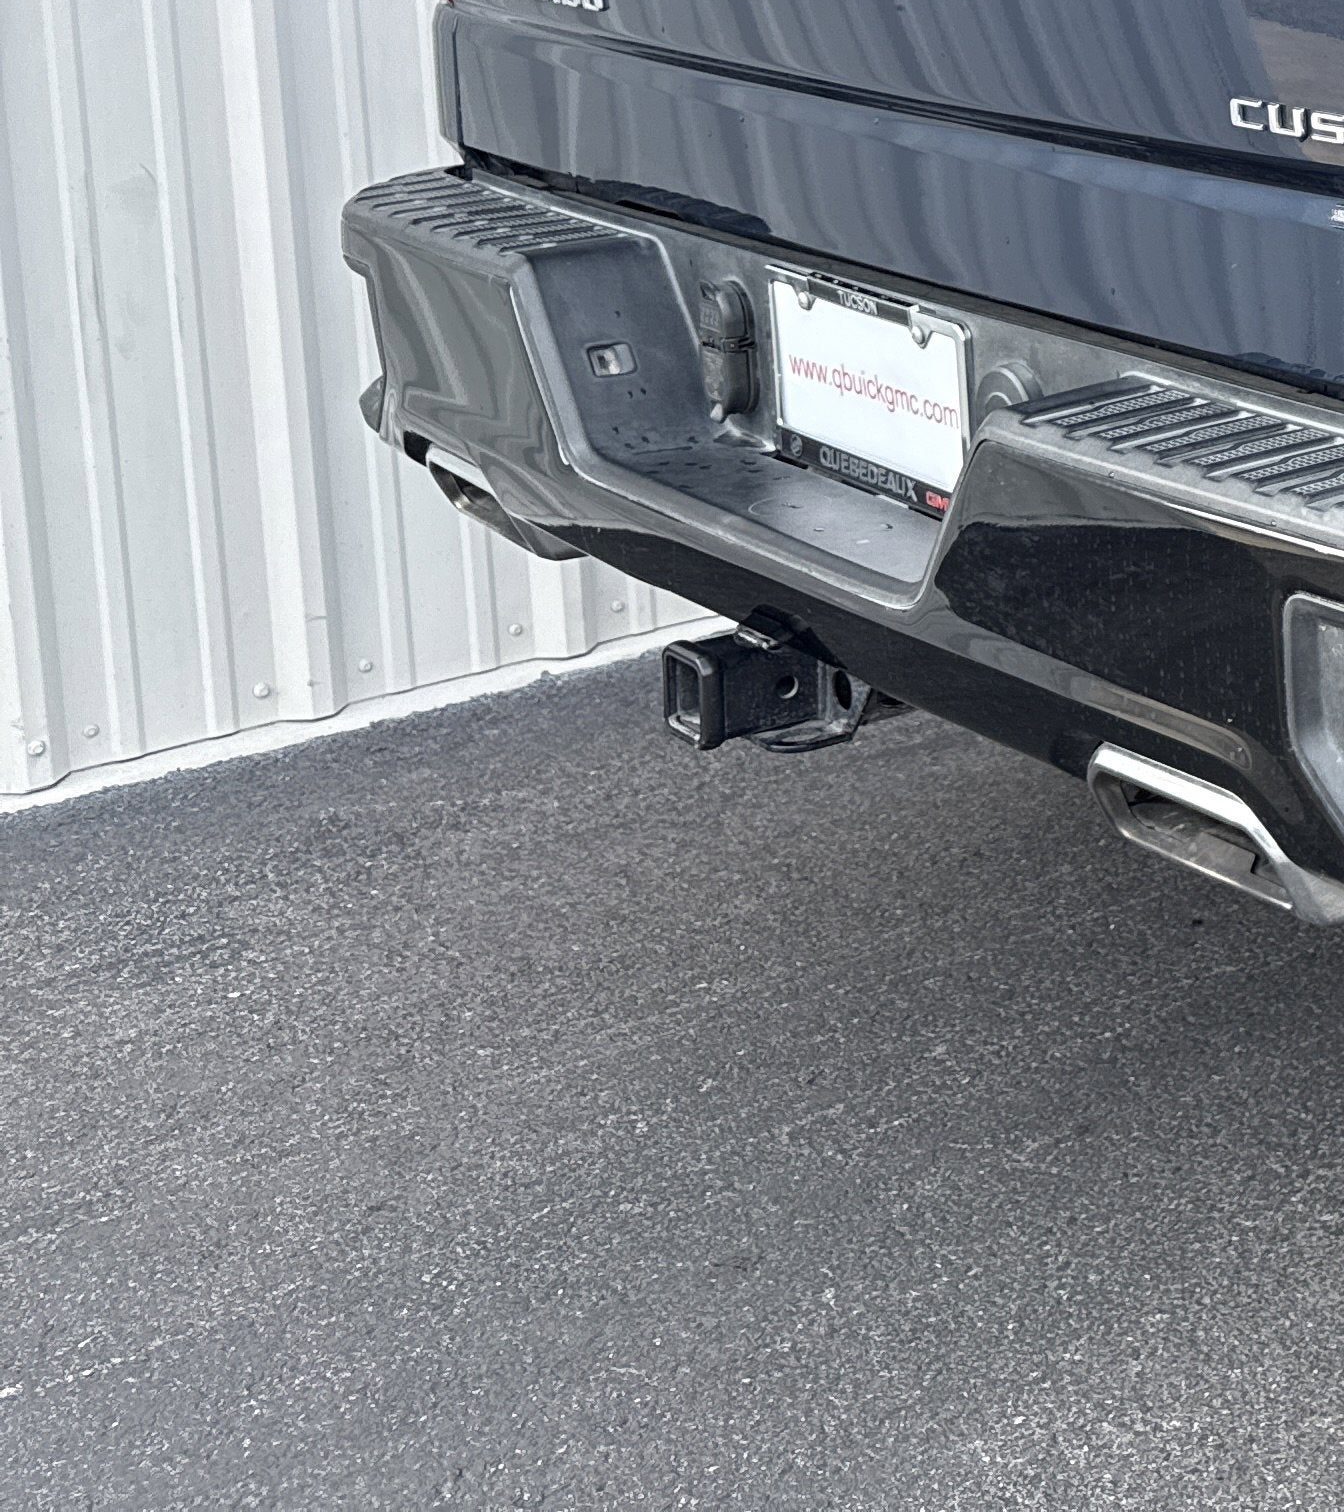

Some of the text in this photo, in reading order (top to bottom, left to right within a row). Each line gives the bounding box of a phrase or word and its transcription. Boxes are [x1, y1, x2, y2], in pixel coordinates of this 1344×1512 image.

[837, 290, 879, 316] TUCSON
[789, 355, 959, 429] www.qbuickgmc.com
[819, 445, 919, 503] QUEBEDEAUX
[925, 490, 950, 512] GM
